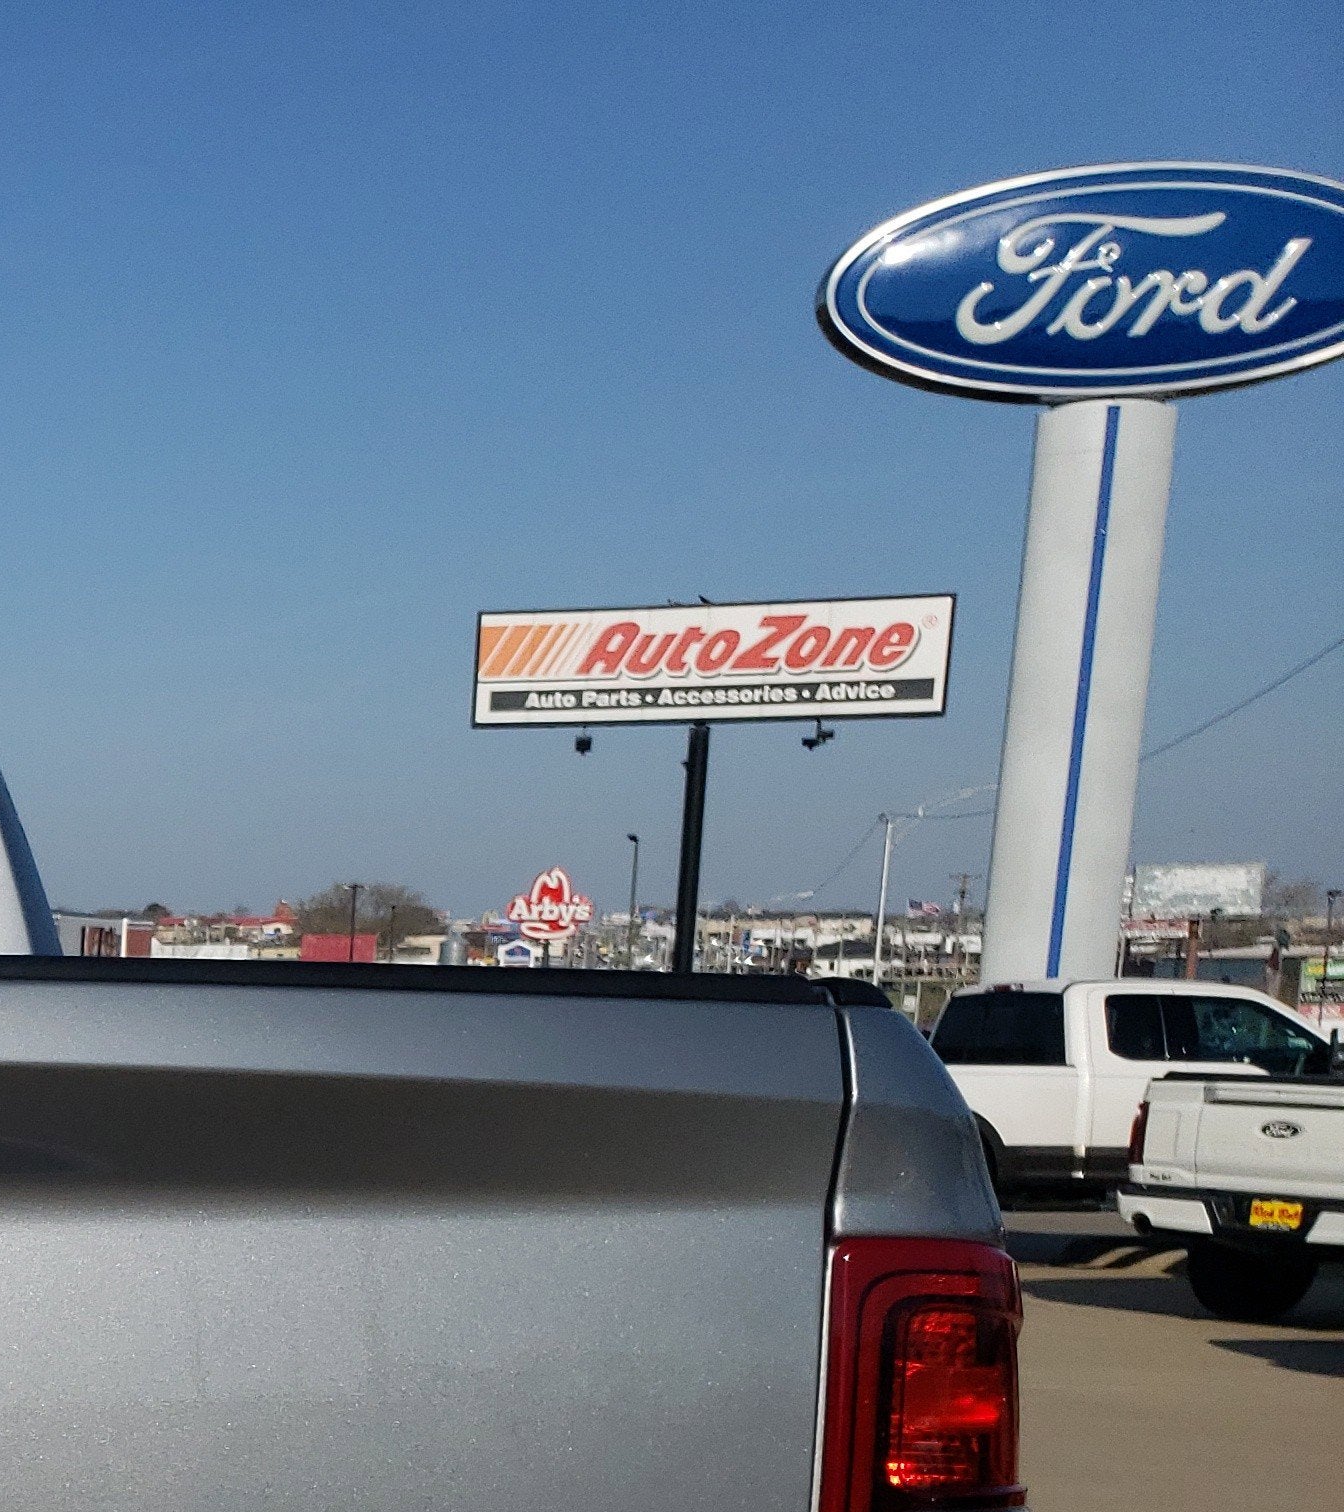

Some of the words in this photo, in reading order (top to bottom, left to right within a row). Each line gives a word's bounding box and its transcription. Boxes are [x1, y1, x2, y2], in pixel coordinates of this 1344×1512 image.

[954, 210, 1314, 345] Ford
[577, 614, 917, 677] AutoZone
[525, 690, 578, 709] Auto
[582, 688, 640, 708] Parts
[660, 685, 796, 706] Accessories
[816, 681, 895, 701] Advice
[509, 895, 592, 926] Arby's
